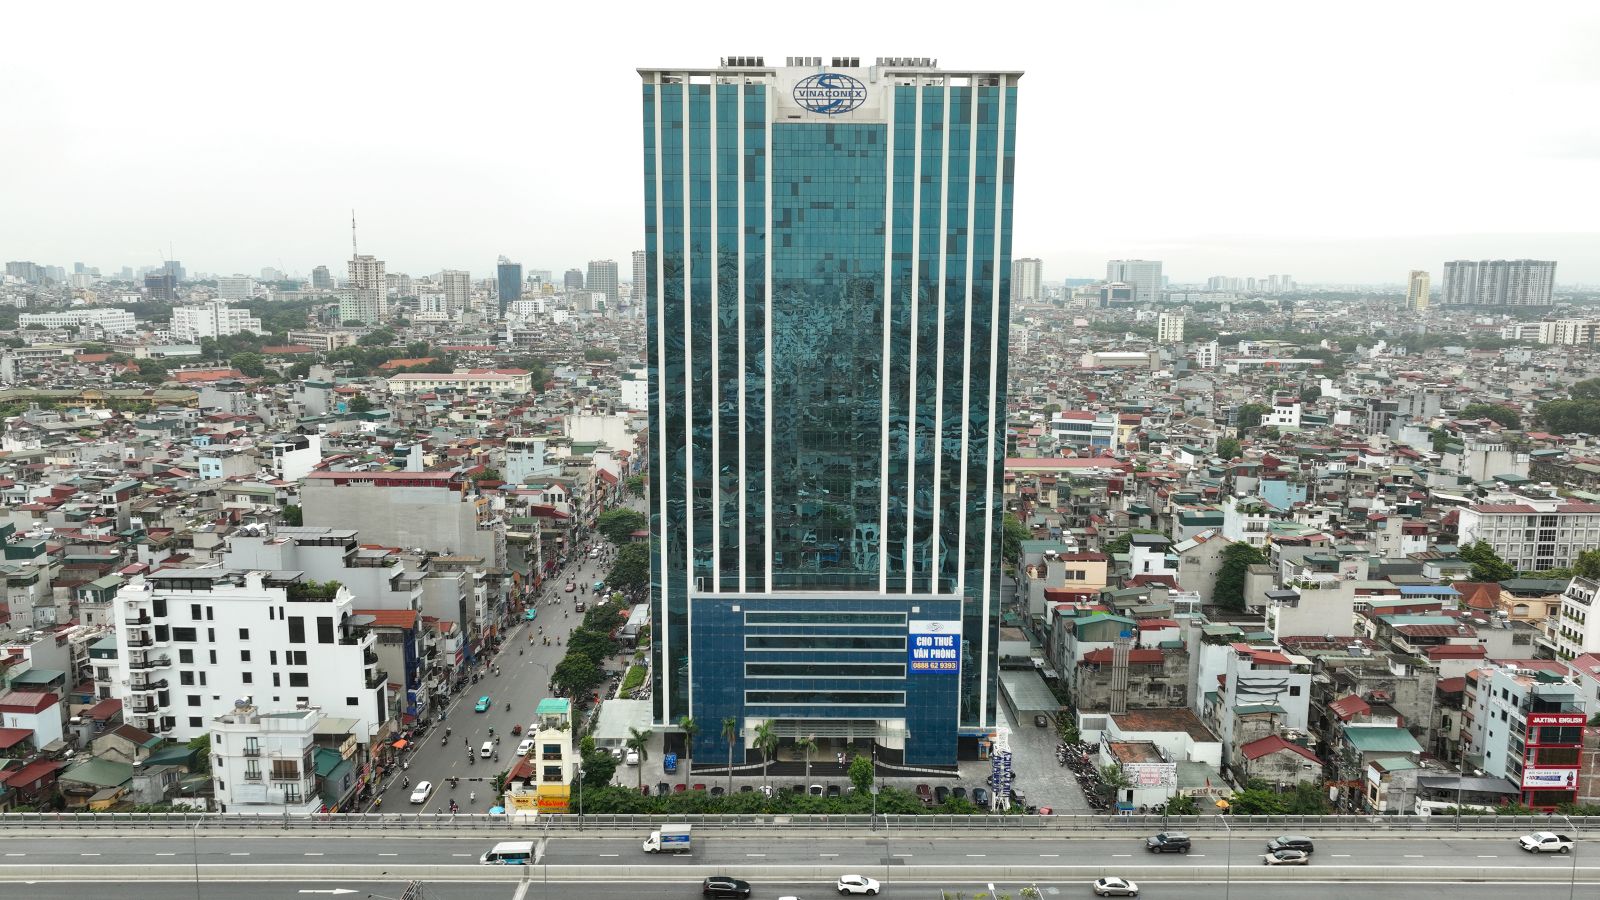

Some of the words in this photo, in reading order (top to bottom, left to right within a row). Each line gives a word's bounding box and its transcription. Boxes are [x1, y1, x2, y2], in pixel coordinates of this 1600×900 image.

[799, 90, 862, 98] VINACONEX
[916, 637, 932, 646] CHO
[934, 636, 953, 646] THUÊ
[930, 648, 956, 659] PHÒNG
